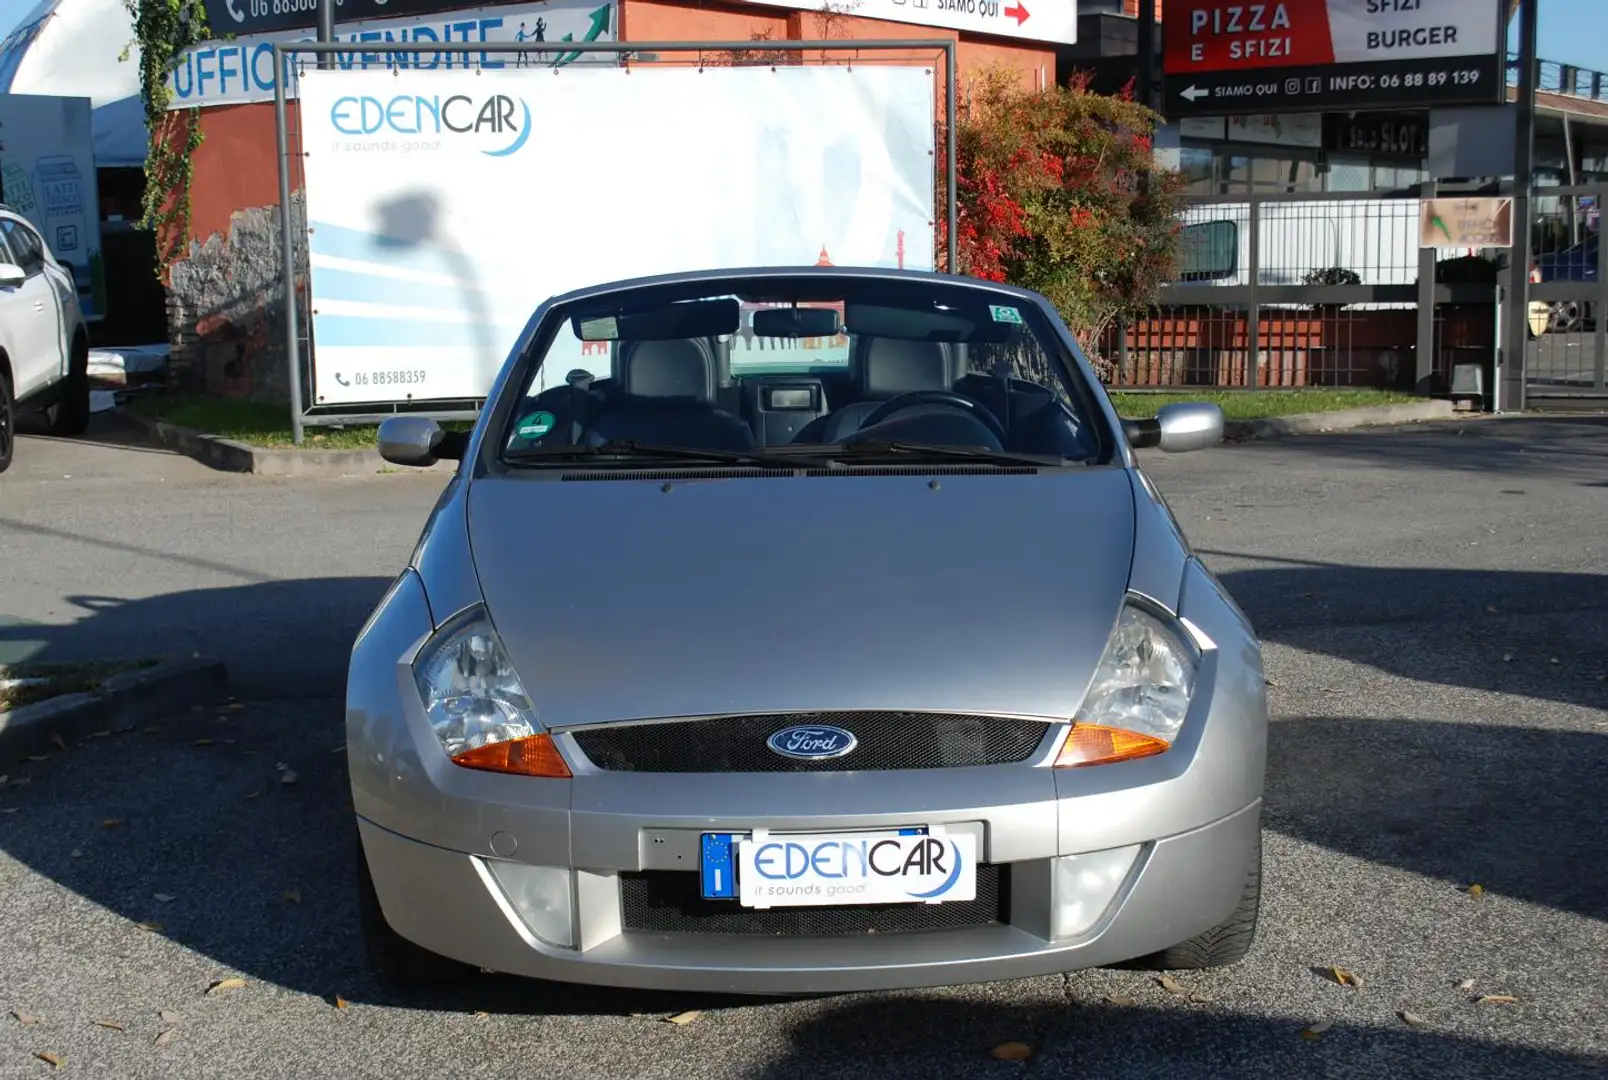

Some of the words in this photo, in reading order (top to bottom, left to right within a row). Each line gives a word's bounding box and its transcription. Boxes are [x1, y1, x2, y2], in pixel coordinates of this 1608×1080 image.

[979, 0, 999, 18] QUI
[1191, 3, 1291, 35] PIZZA
[1366, 26, 1457, 49] BURGER
[1191, 44, 1204, 61] E
[1229, 38, 1291, 59] SFIZI
[1214, 85, 1253, 97] SIAMO
[1256, 84, 1277, 96] QUI
[1329, 76, 1375, 91] INFO:
[1380, 75, 1400, 88] 06
[1404, 74, 1422, 87] 88
[1427, 73, 1446, 86] 89
[1452, 71, 1480, 85] 139
[330, 94, 517, 135] EDENCAR
[355, 372, 369, 385] 06
[372, 370, 426, 385] 88588359
[786, 730, 838, 750] Ford
[754, 837, 947, 880] EDENCAR
[768, 883, 822, 895] sounds
